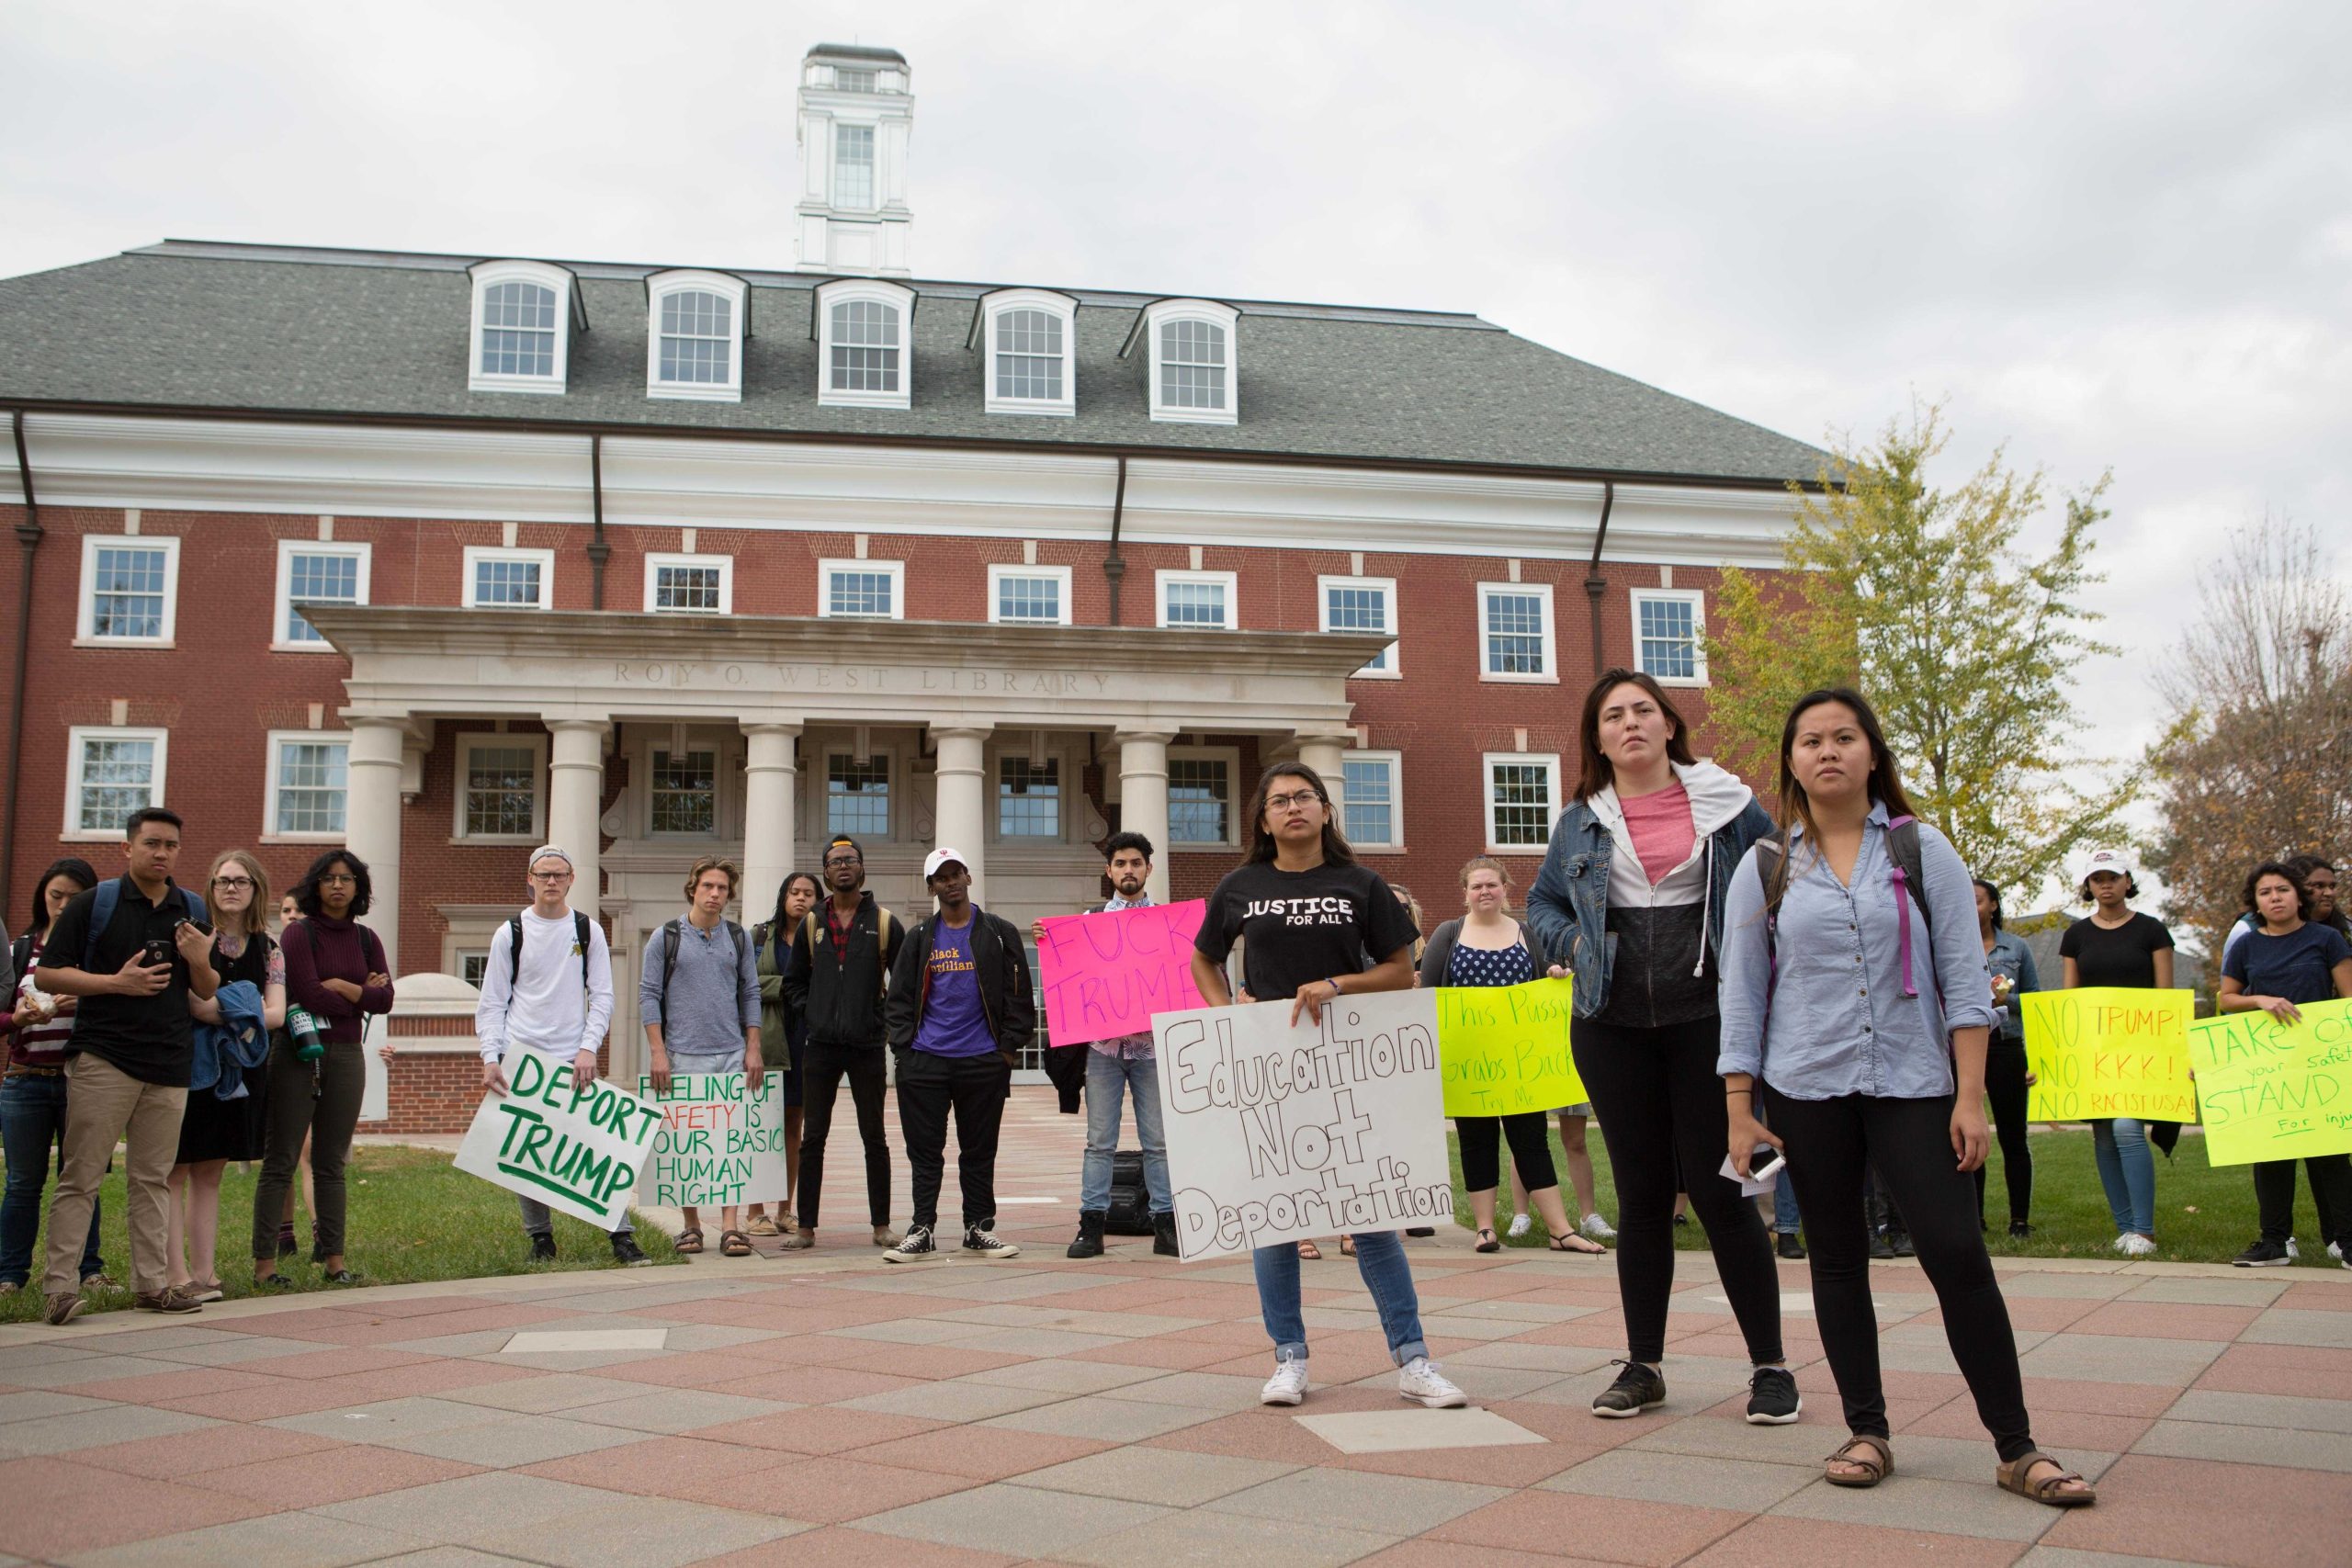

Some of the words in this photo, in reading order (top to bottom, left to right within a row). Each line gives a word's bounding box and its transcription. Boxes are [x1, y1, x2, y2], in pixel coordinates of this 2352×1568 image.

[614, 662, 697, 684] ROY
[725, 665, 749, 685] O.
[778, 667, 889, 688] WEST
[922, 671, 1110, 694] LIBRARY
[1243, 897, 1353, 919] JUSTICE
[1286, 915, 1313, 926] FOR
[1319, 914, 1342, 925] ALL
[1044, 906, 1196, 966] FUCK
[1437, 991, 1496, 1030] This
[1508, 988, 1570, 1040] Pussy
[2034, 997, 2080, 1050] NO
[2087, 1006, 2183, 1036] TRUMP!
[1164, 1002, 1435, 1114] Education
[2040, 1054, 2080, 1089] NO
[2246, 1061, 2285, 1086] your
[510, 1054, 663, 1146] DEPORT
[752, 1074, 778, 1103] OF
[1469, 1089, 1504, 1116] Try
[1514, 1085, 1535, 1107] Me
[2205, 1074, 2340, 1125] STAND
[659, 1103, 737, 1130] AFETY
[745, 1103, 762, 1129] IS
[2038, 1090, 2079, 1121] NO
[2090, 1092, 2146, 1113] RACIST
[2153, 1095, 2195, 1116] USA!
[1240, 1089, 1373, 1180] Not
[2278, 1118, 2310, 1131] For
[499, 1103, 635, 1203] TRUMP
[653, 1130, 714, 1156] OUR
[727, 1128, 784, 1155] BASIC
[656, 1156, 752, 1183] HUMAN
[657, 1182, 746, 1207] RIGHT
[1172, 1156, 1454, 1259] Deportation
